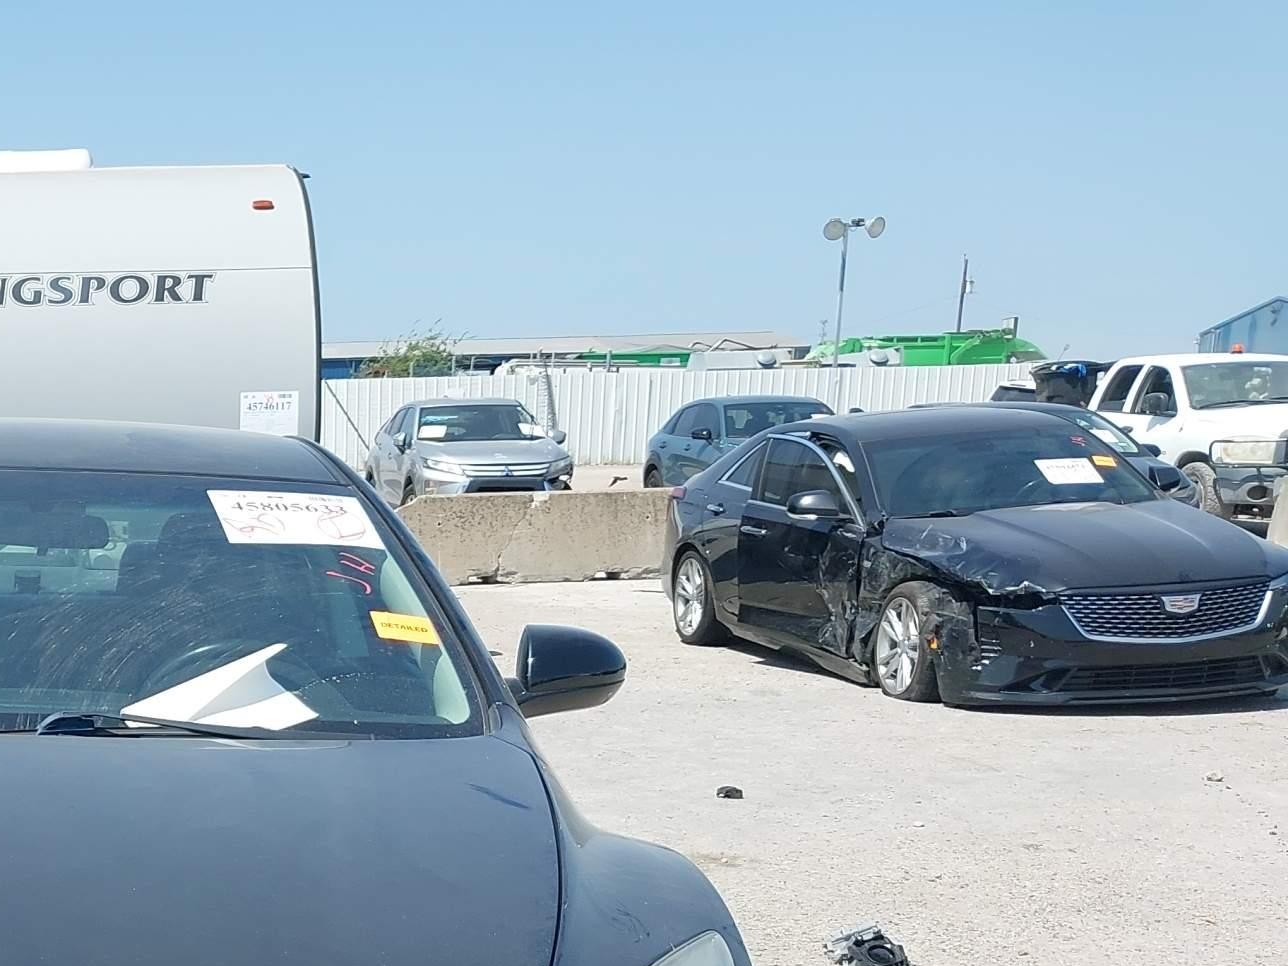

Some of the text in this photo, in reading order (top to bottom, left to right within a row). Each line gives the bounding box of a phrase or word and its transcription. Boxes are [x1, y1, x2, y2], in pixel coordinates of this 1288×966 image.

[246, 402, 292, 411] 45746117
[232, 501, 348, 515] 45805633
[380, 622, 429, 633] DETAILED
